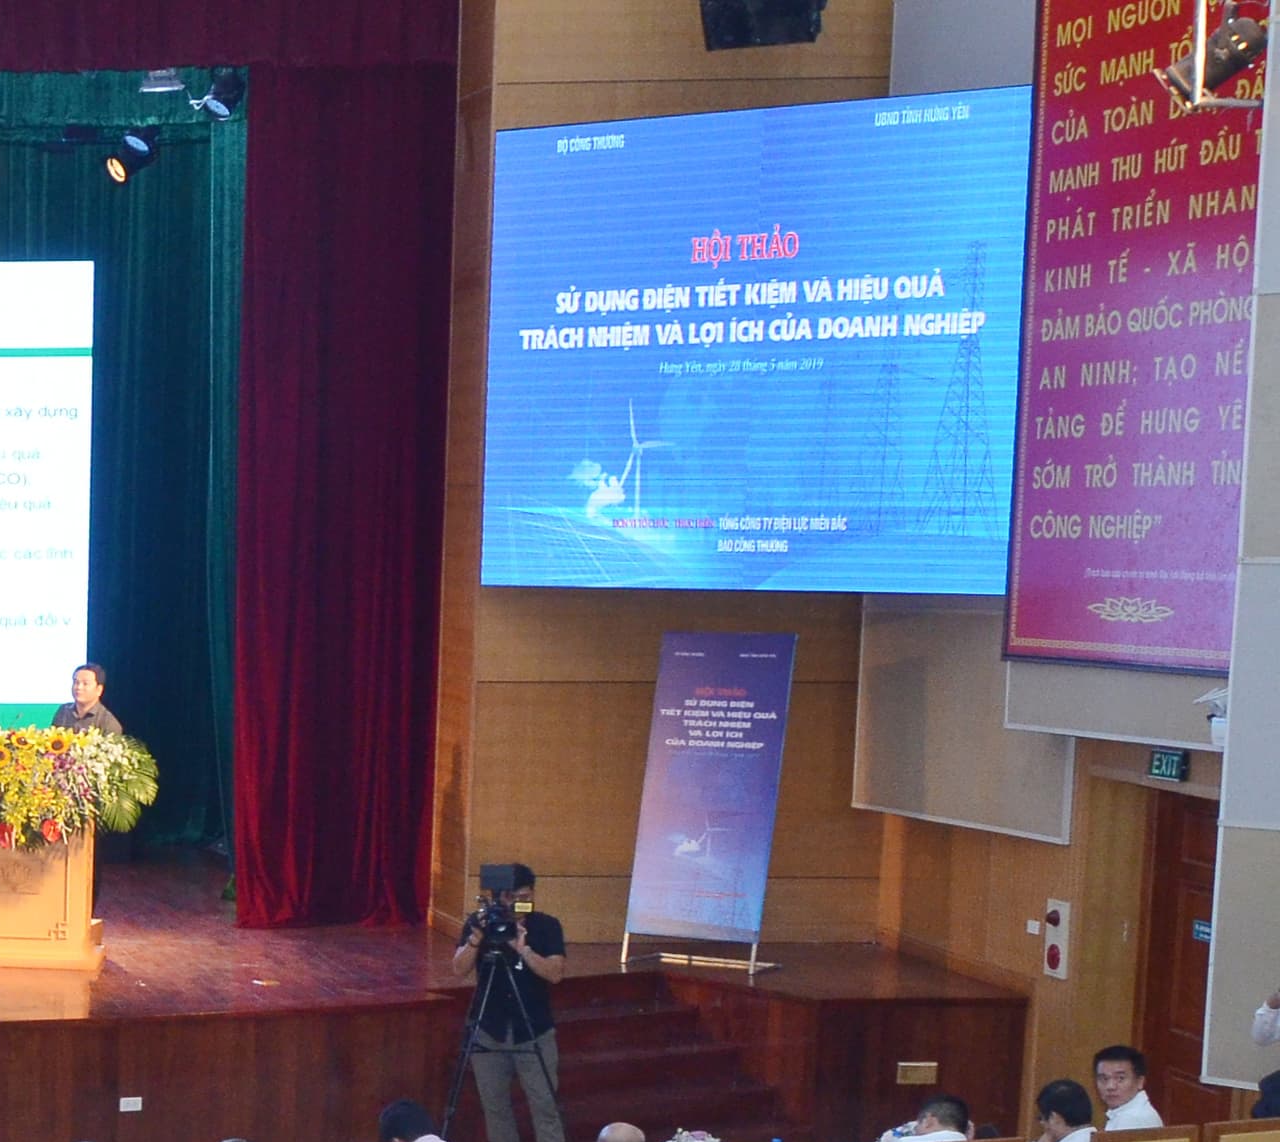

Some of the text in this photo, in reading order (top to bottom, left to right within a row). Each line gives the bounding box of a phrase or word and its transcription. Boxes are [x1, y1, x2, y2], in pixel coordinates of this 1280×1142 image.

[1056, 16, 1093, 48] MỌI
[1053, 48, 1155, 97] SỨC MẠNH
[1051, 109, 1089, 146] CỦA
[1103, 95, 1155, 135] TOÀN
[1049, 125, 1242, 201] MẠNH THU HÚT ĐẦU
[1045, 184, 1256, 243] PHÁT TRIỂN NHAN
[691, 223, 799, 269] HỘI THẢO
[1045, 264, 1091, 293] KINH
[1108, 248, 1130, 284] TẾ
[1167, 242, 1197, 277] XÃ
[1216, 235, 1249, 273] HỘ
[556, 267, 945, 316] SỬ DỤNG ĐIỆN TIẾT KIỆM VÀ HIỆU QUẢ
[519, 308, 986, 352] TRÁCH NHIỆM VÀ LỢI ÍCH CỦA DOANH NGHIỆP
[1041, 308, 1079, 342] ĐẢM
[1085, 303, 1122, 337] BẢO
[1127, 296, 1183, 333] QUỐC
[1039, 365, 1066, 390] AN
[1080, 360, 1138, 387] NINH;
[1153, 353, 1197, 387] TẠO
[1036, 399, 1244, 440] TẢNG ĐỂ HƯNG YÊ
[1032, 450, 1240, 490] SỚM TRỞ THÀNH TỈN
[1030, 509, 1082, 539] CÔNG
[1151, 753, 1178, 777] EXIT
